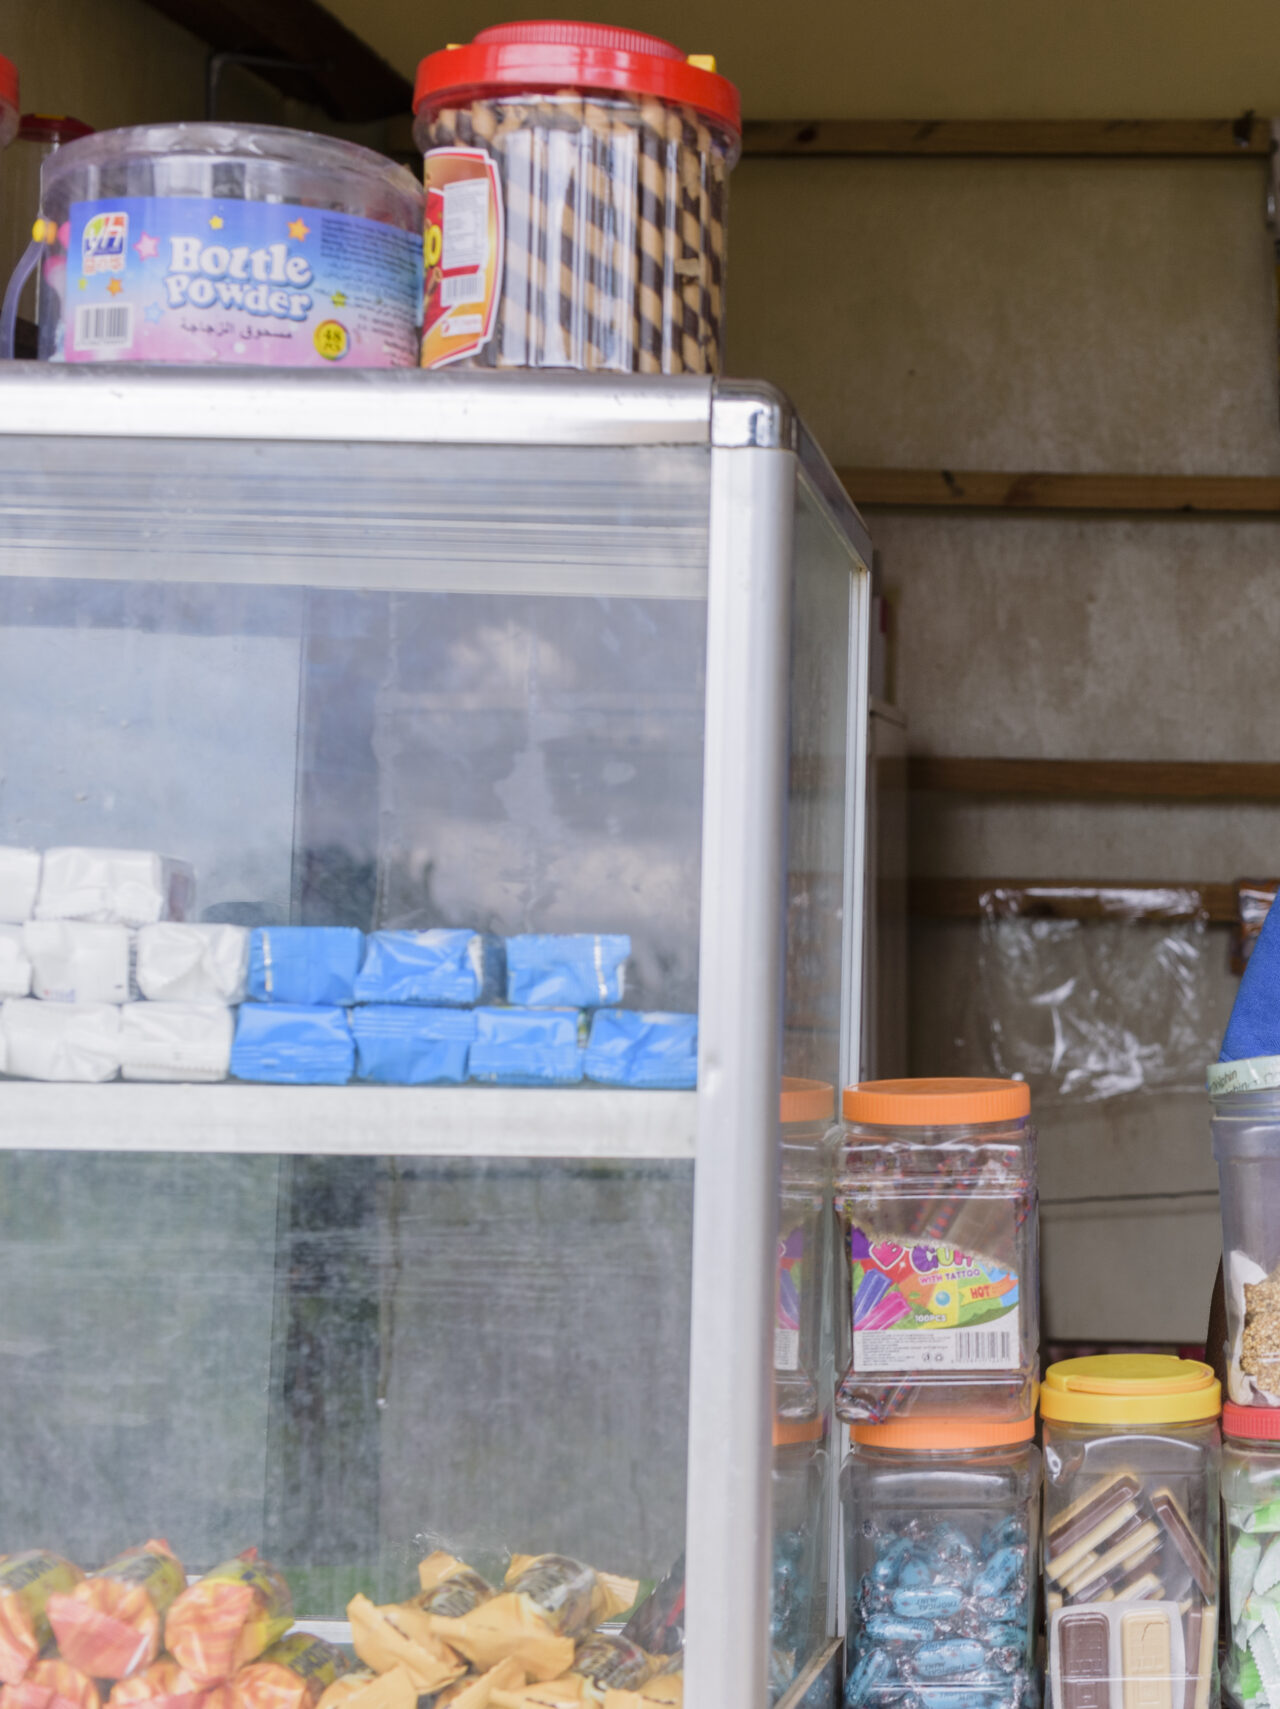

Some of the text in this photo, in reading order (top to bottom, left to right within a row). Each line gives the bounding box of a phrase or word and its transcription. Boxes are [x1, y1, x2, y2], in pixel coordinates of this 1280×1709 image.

[169, 236, 313, 284] Bottle
[165, 274, 312, 319] Powder
[920, 1268, 981, 1285] WITH TATTOO
[970, 1285, 991, 1300] HOT
